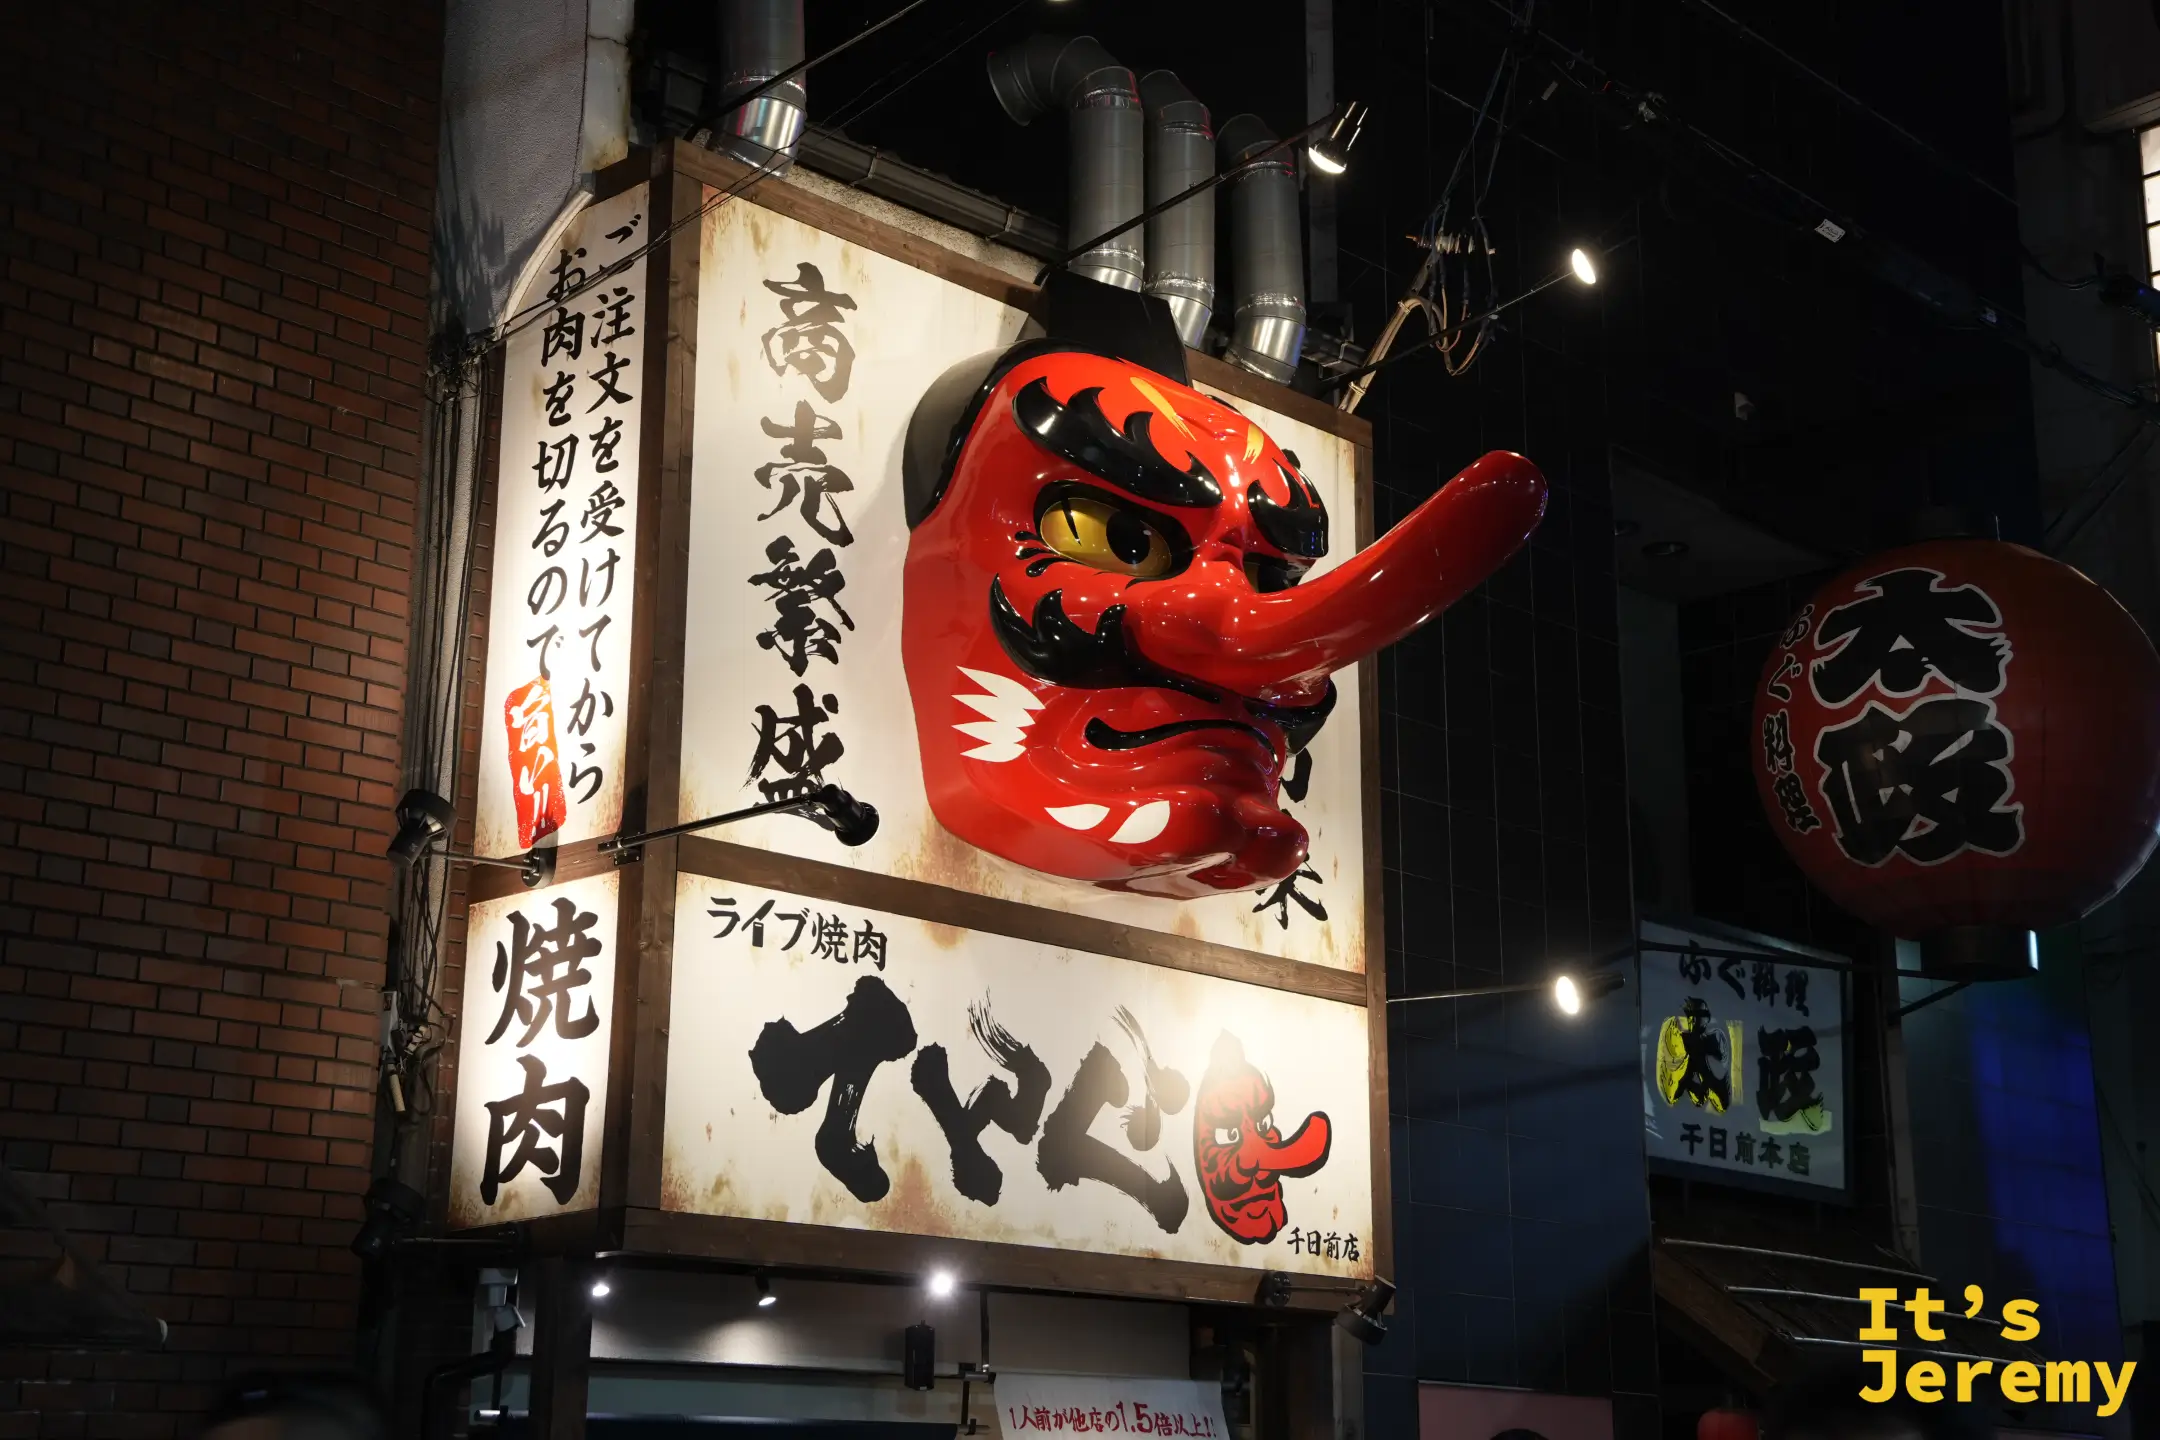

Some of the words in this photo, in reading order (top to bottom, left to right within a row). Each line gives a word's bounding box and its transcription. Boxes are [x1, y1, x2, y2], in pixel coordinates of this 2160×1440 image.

[526, 248, 587, 682] お肉を切るので
[566, 213, 642, 805] ご注文を受けてから
[738, 261, 857, 832] 商売繁盛
[479, 896, 603, 1206] 焼肉
[706, 896, 888, 972] ライブ焼肉
[1679, 940, 1810, 1018] ふぐ料理
[748, 975, 1191, 1235] てんぐ
[1679, 1122, 1811, 1177] 千日前本店
[1286, 1226, 1361, 1263] 千日前店
